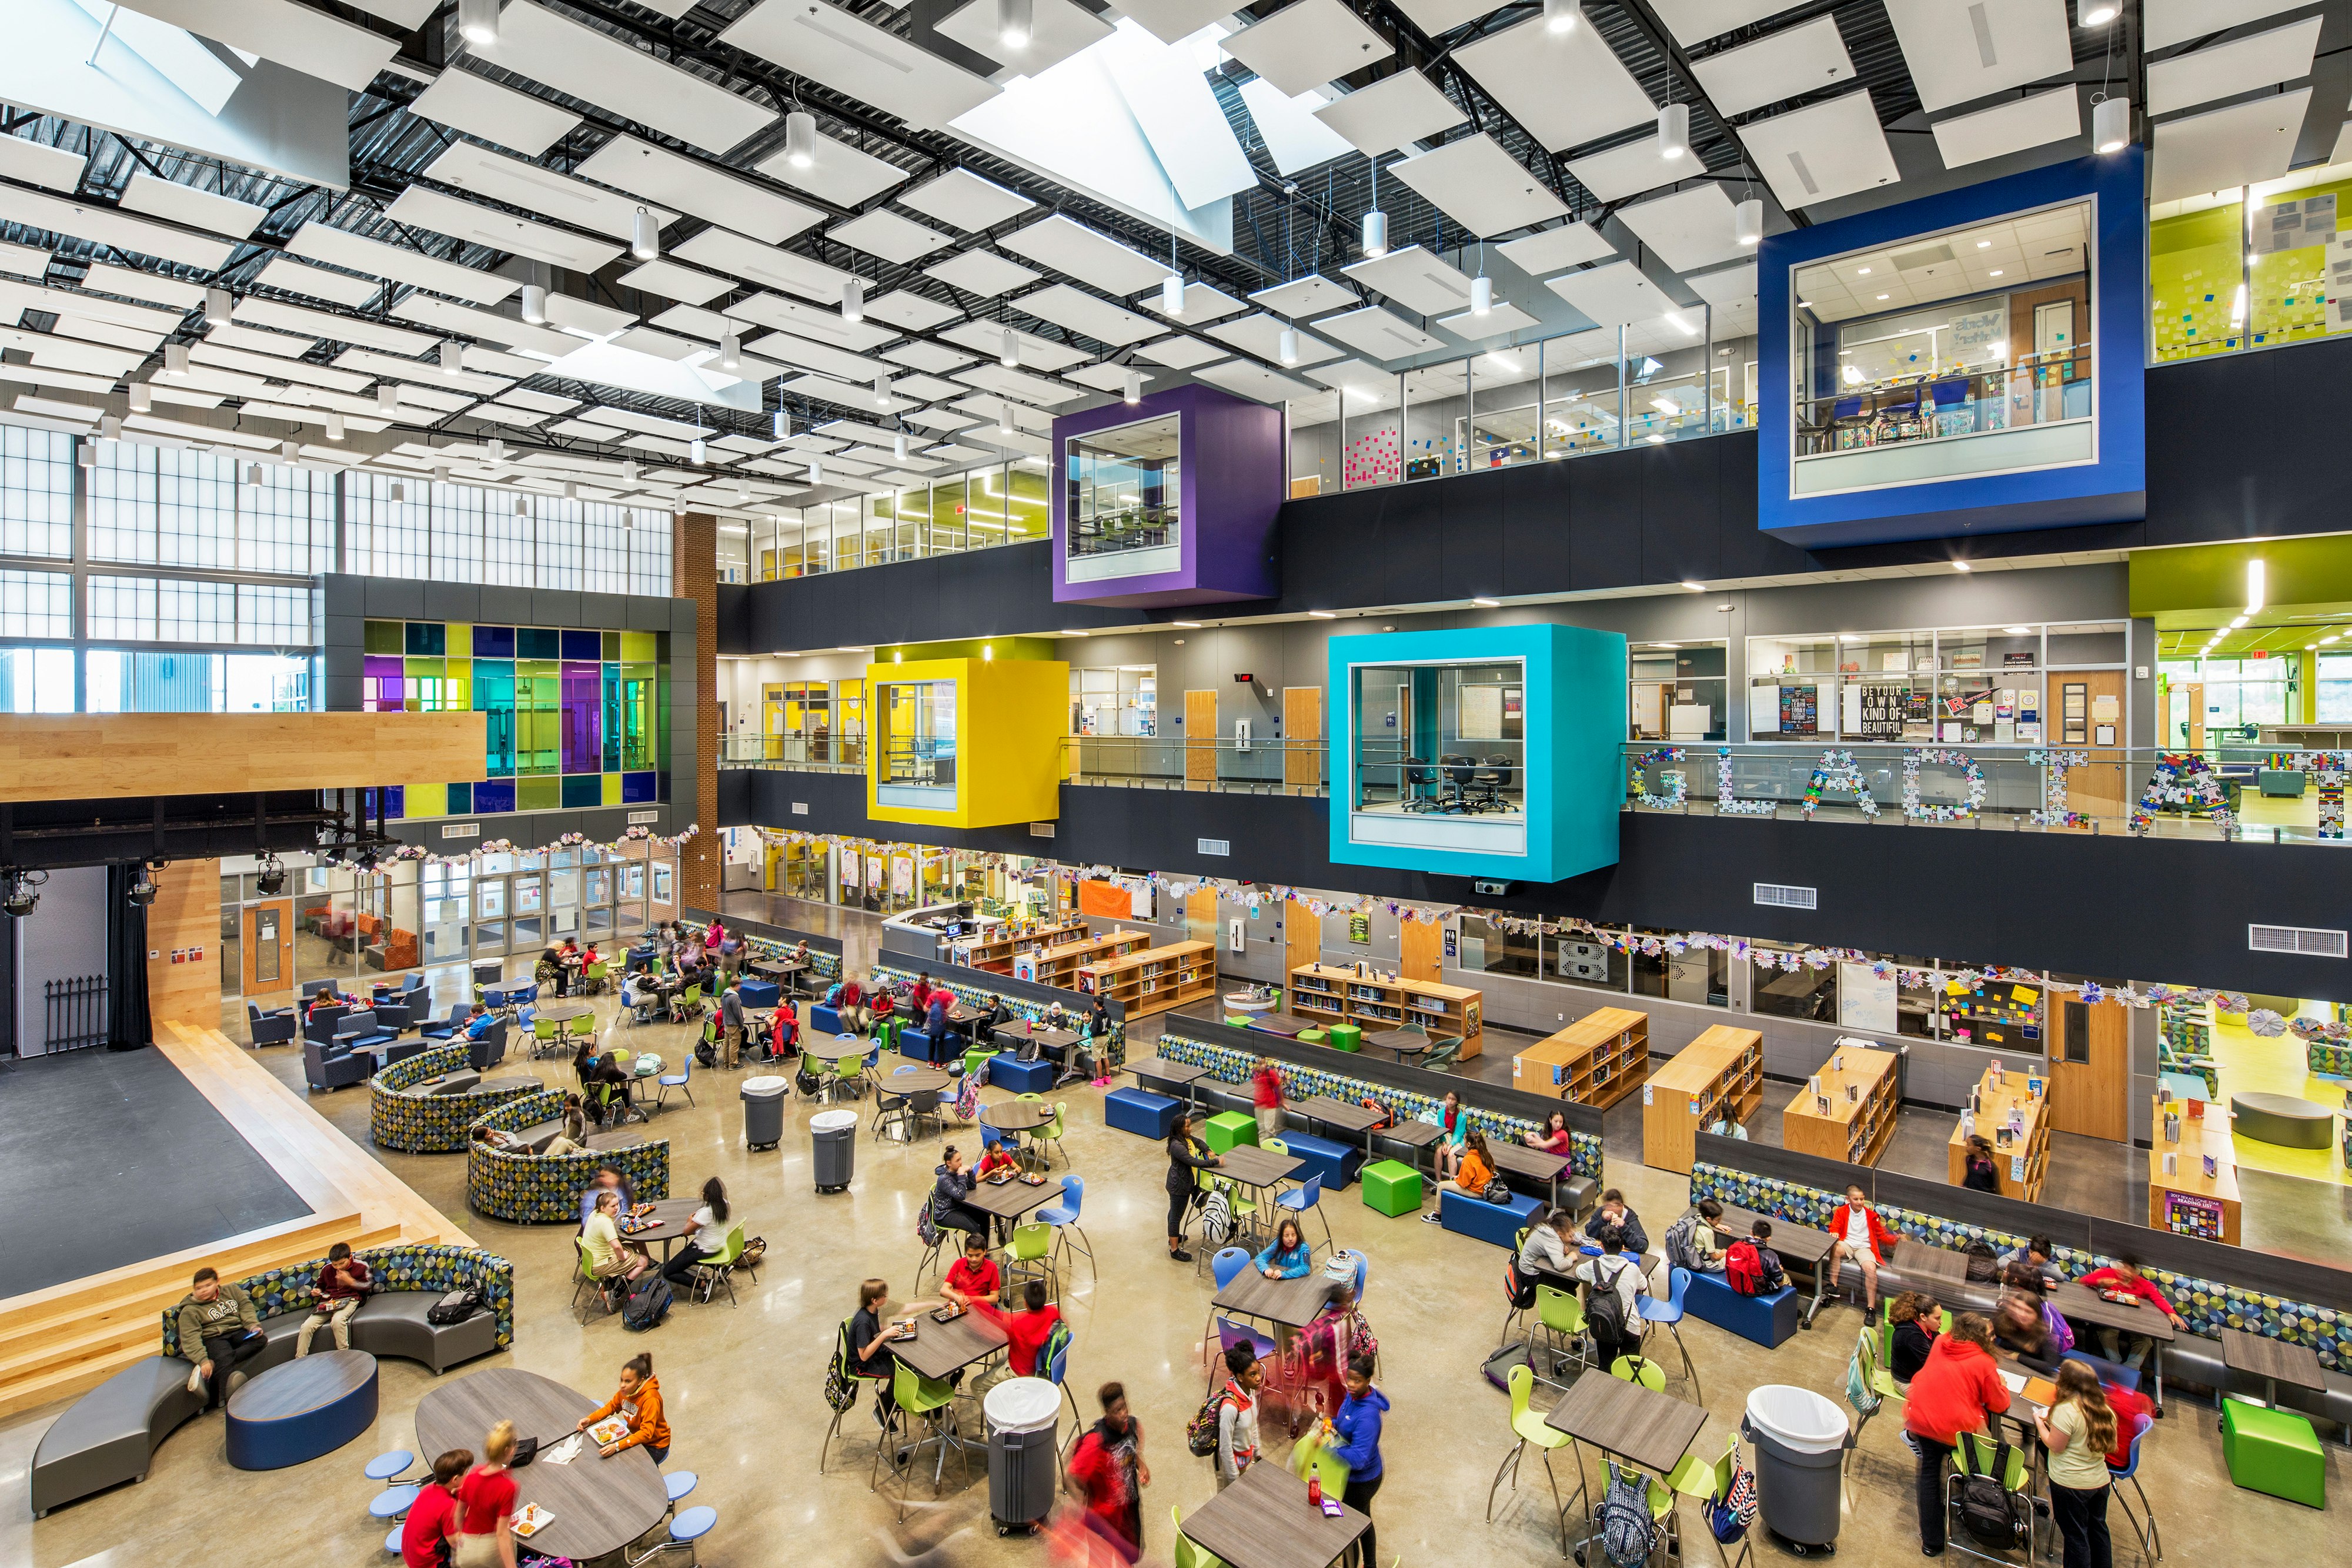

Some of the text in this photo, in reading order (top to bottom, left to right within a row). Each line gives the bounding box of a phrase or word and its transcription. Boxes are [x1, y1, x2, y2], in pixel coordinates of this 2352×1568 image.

[2254, 651, 2266, 659] EXIT
[1862, 686, 1902, 697] BE YOUR
[1965, 690, 1992, 703] RUTGERS
[1867, 696, 1896, 707] OWN
[1947, 696, 1969, 713] R
[1862, 707, 1886, 721] KIND
[1889, 707, 1902, 721] OF
[1862, 722, 1902, 734] BEAUTIFUL
[2177, 1198, 2201, 1206] READING
[208, 1299, 238, 1322] GAP
